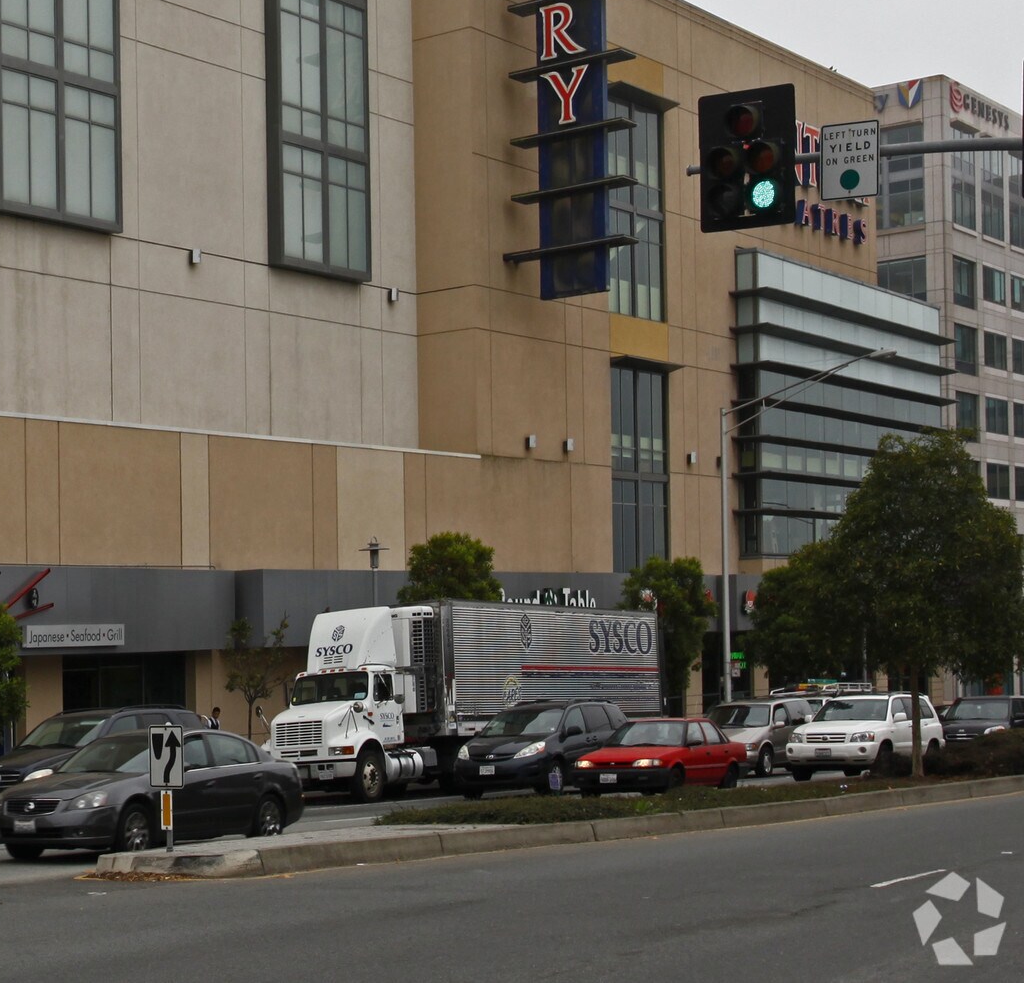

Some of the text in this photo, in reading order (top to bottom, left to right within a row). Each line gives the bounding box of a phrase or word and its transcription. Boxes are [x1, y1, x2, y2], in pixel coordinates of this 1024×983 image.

[962, 93, 1010, 131] GENESYS
[823, 127, 876, 141] LEFT TURN
[829, 140, 871, 153] YIELD
[825, 153, 875, 167] ON GREEN
[796, 199, 867, 245] ATRES
[28, 627, 123, 646] Japanese Seafood Grill
[588, 619, 653, 656] SYSCO
[315, 643, 353, 658] SYSCO
